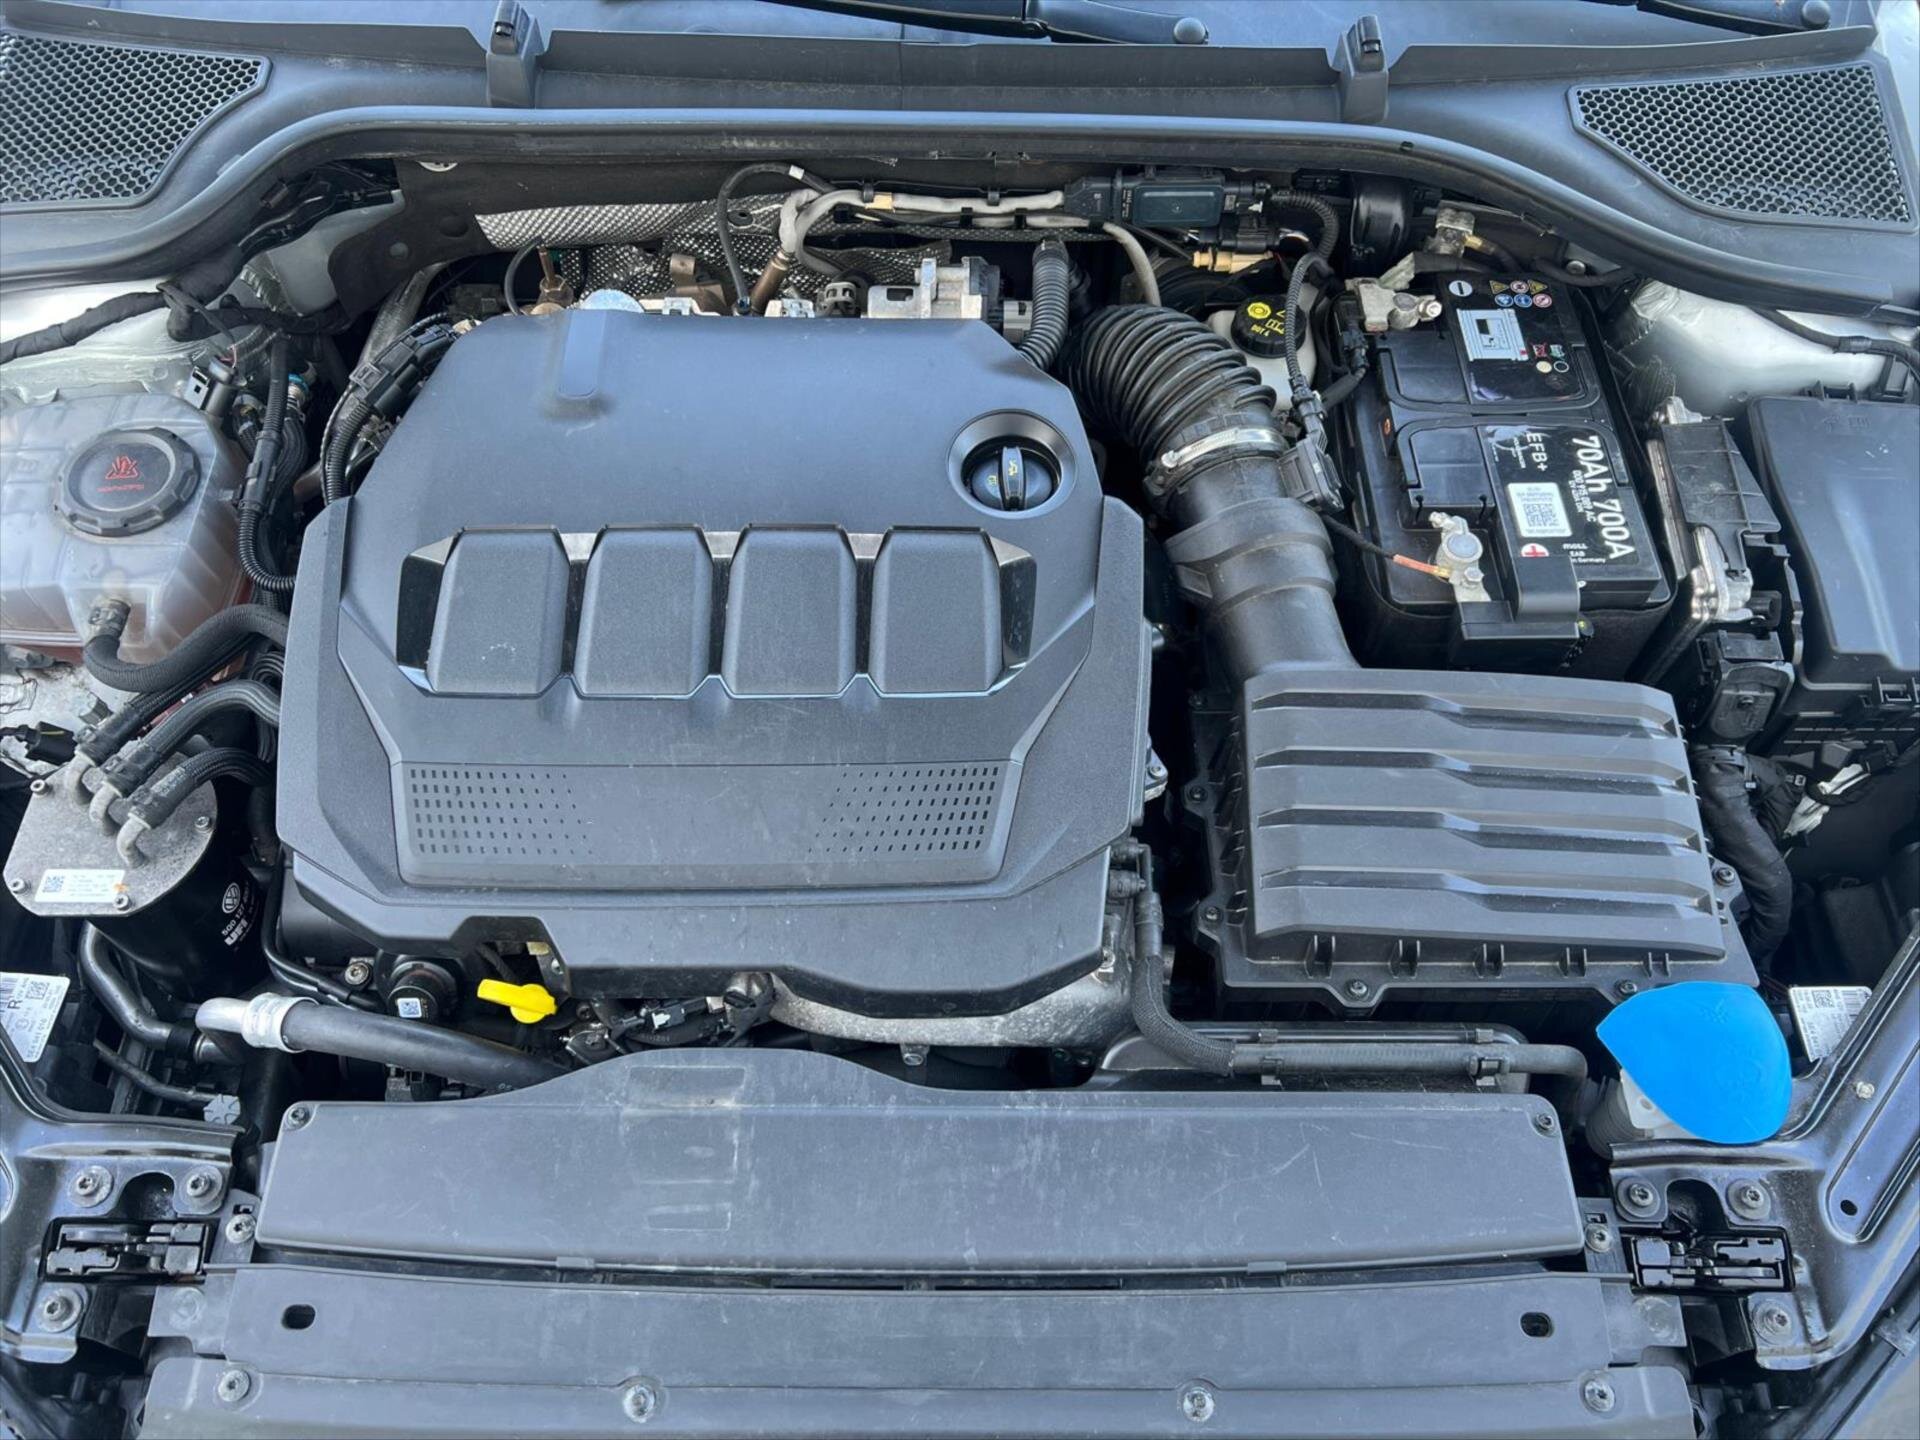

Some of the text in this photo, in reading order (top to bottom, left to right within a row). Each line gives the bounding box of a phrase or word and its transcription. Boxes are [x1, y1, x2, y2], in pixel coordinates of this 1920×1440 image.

[1526, 432, 1548, 472] EFB+
[1572, 435, 1635, 560] 70Ah 700A
[7, 999, 23, 1010] R
